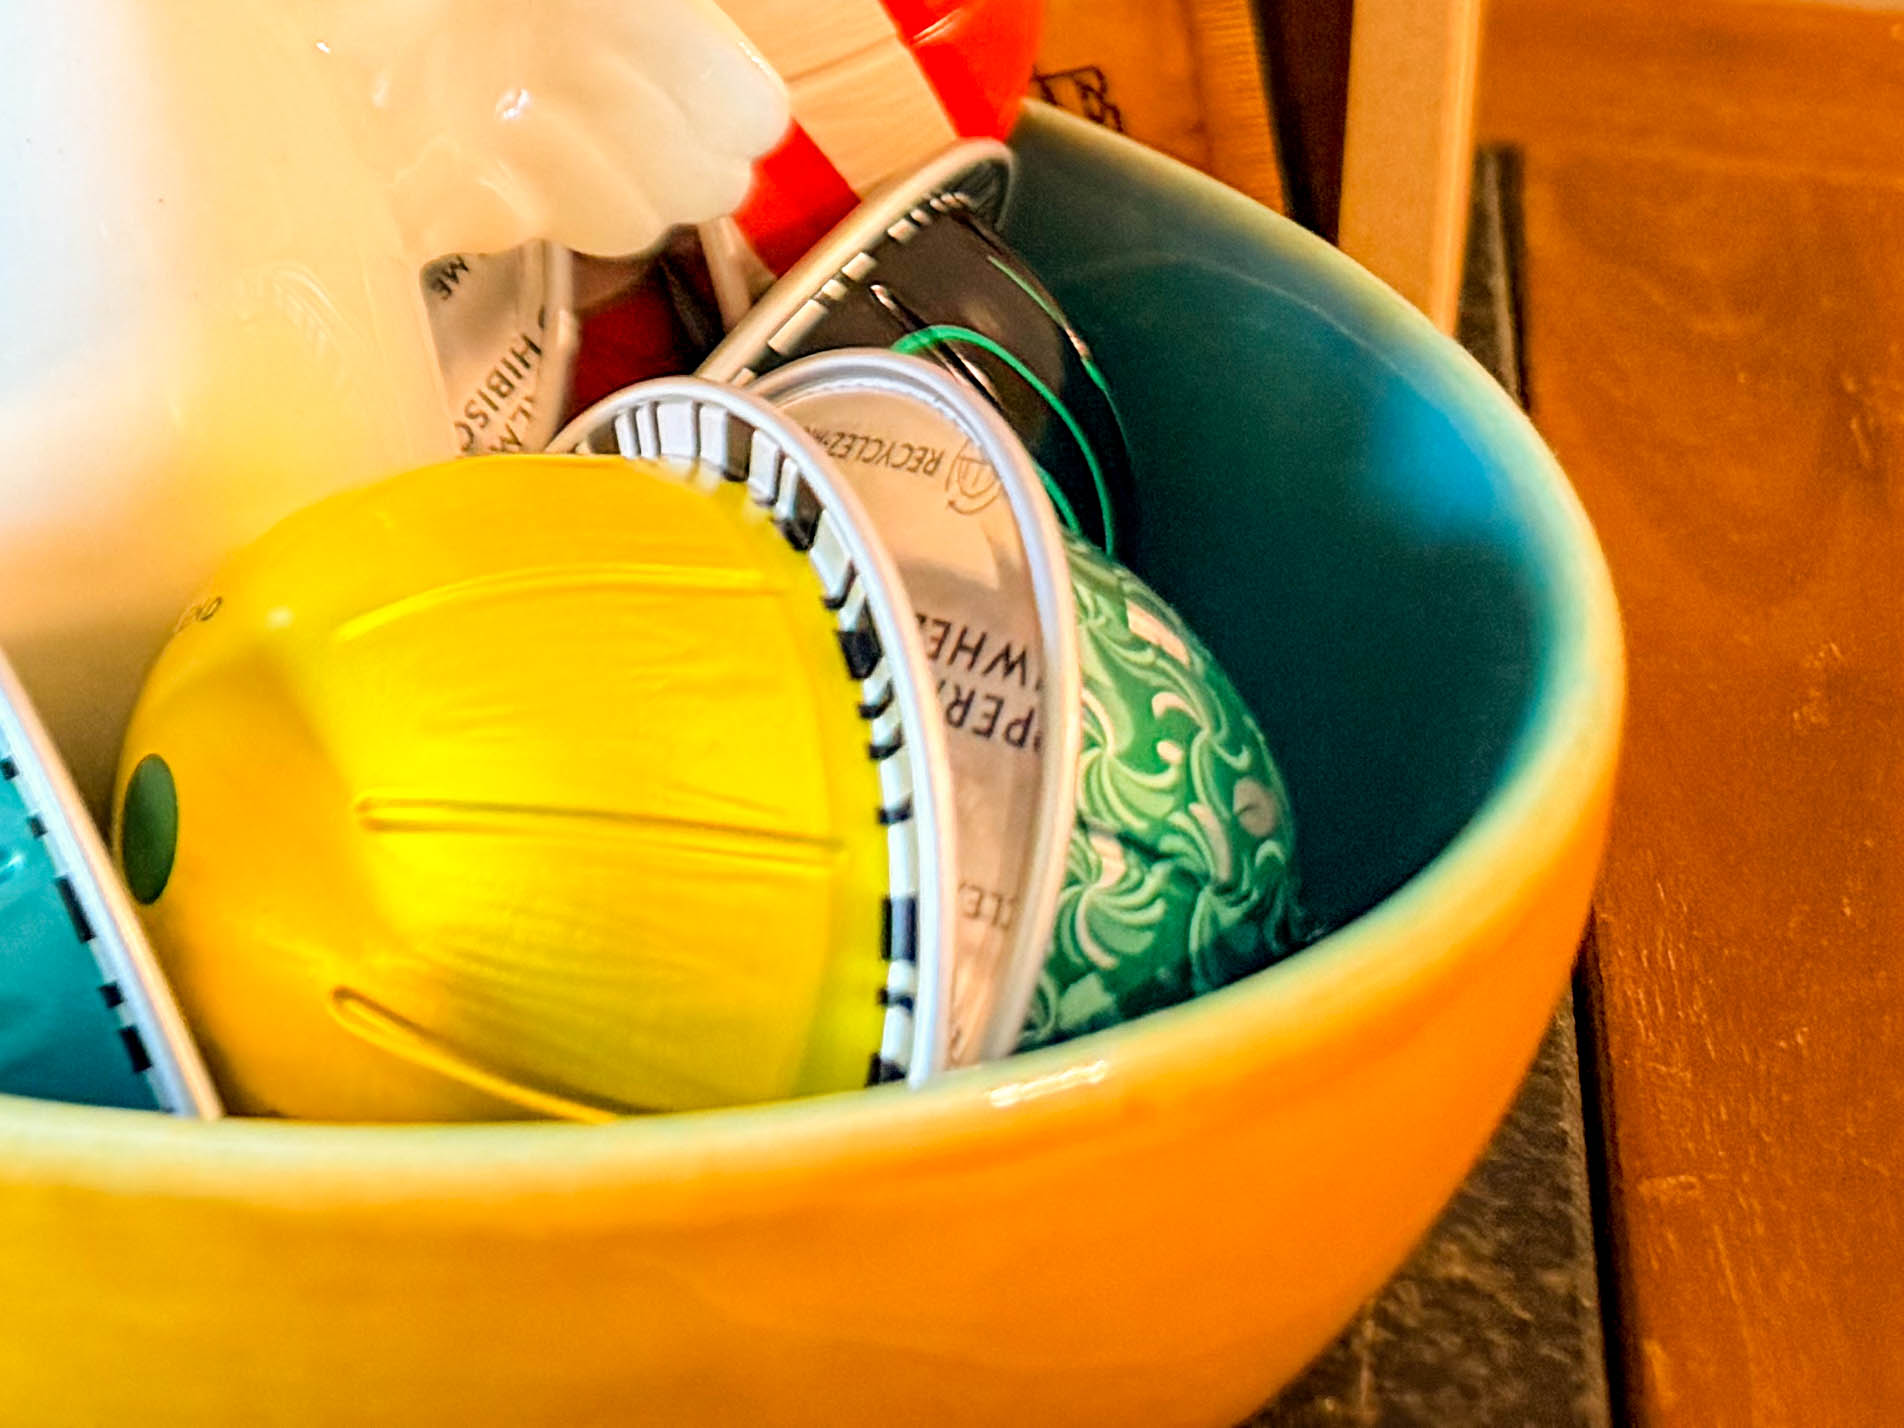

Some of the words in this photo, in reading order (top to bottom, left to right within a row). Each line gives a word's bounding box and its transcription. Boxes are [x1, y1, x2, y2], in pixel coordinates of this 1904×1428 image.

[454, 332, 543, 453] HIBISC
[916, 612, 1043, 692] WHE
[936, 679, 1042, 754] PER
